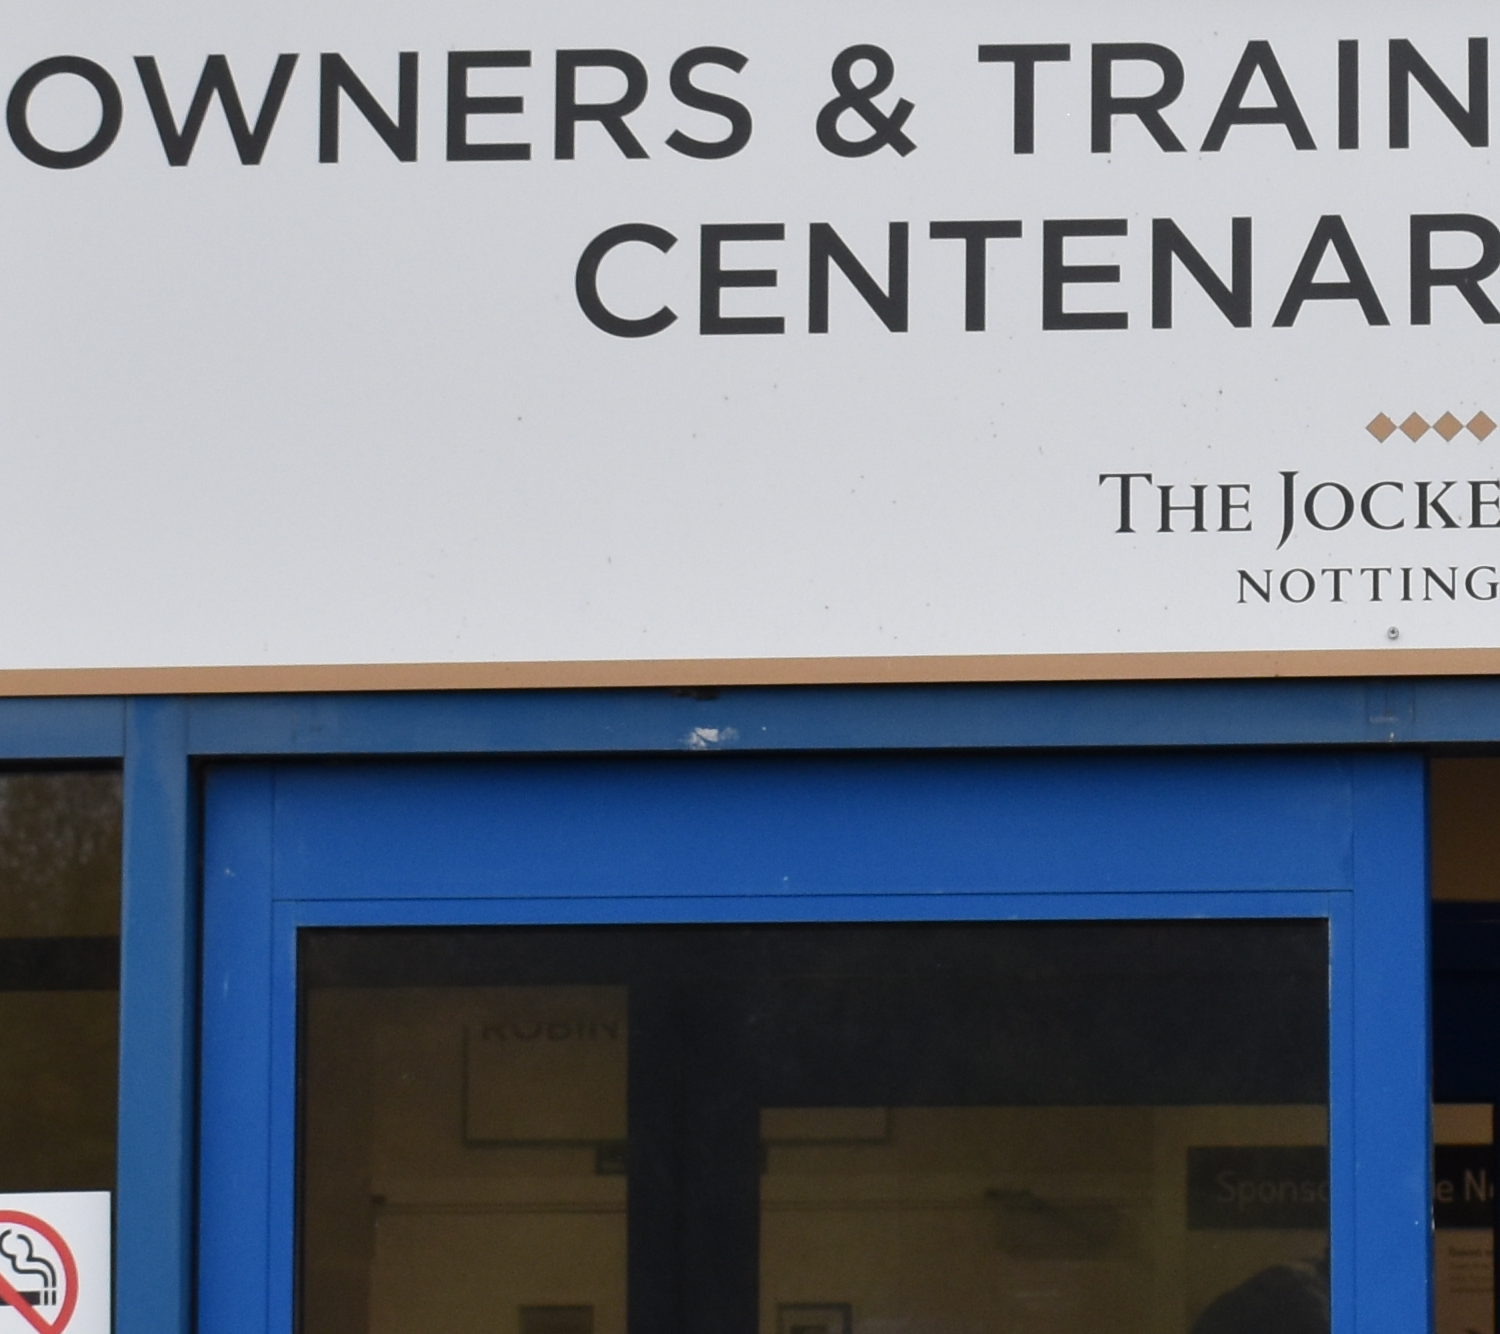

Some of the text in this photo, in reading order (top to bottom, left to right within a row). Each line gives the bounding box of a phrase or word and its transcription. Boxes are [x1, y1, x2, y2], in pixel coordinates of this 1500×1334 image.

[6, 46, 752, 169] OWNERS
[816, 44, 916, 158] &
[1099, 474, 1251, 533] THE
[1215, 1169, 1329, 1212] Sponso
